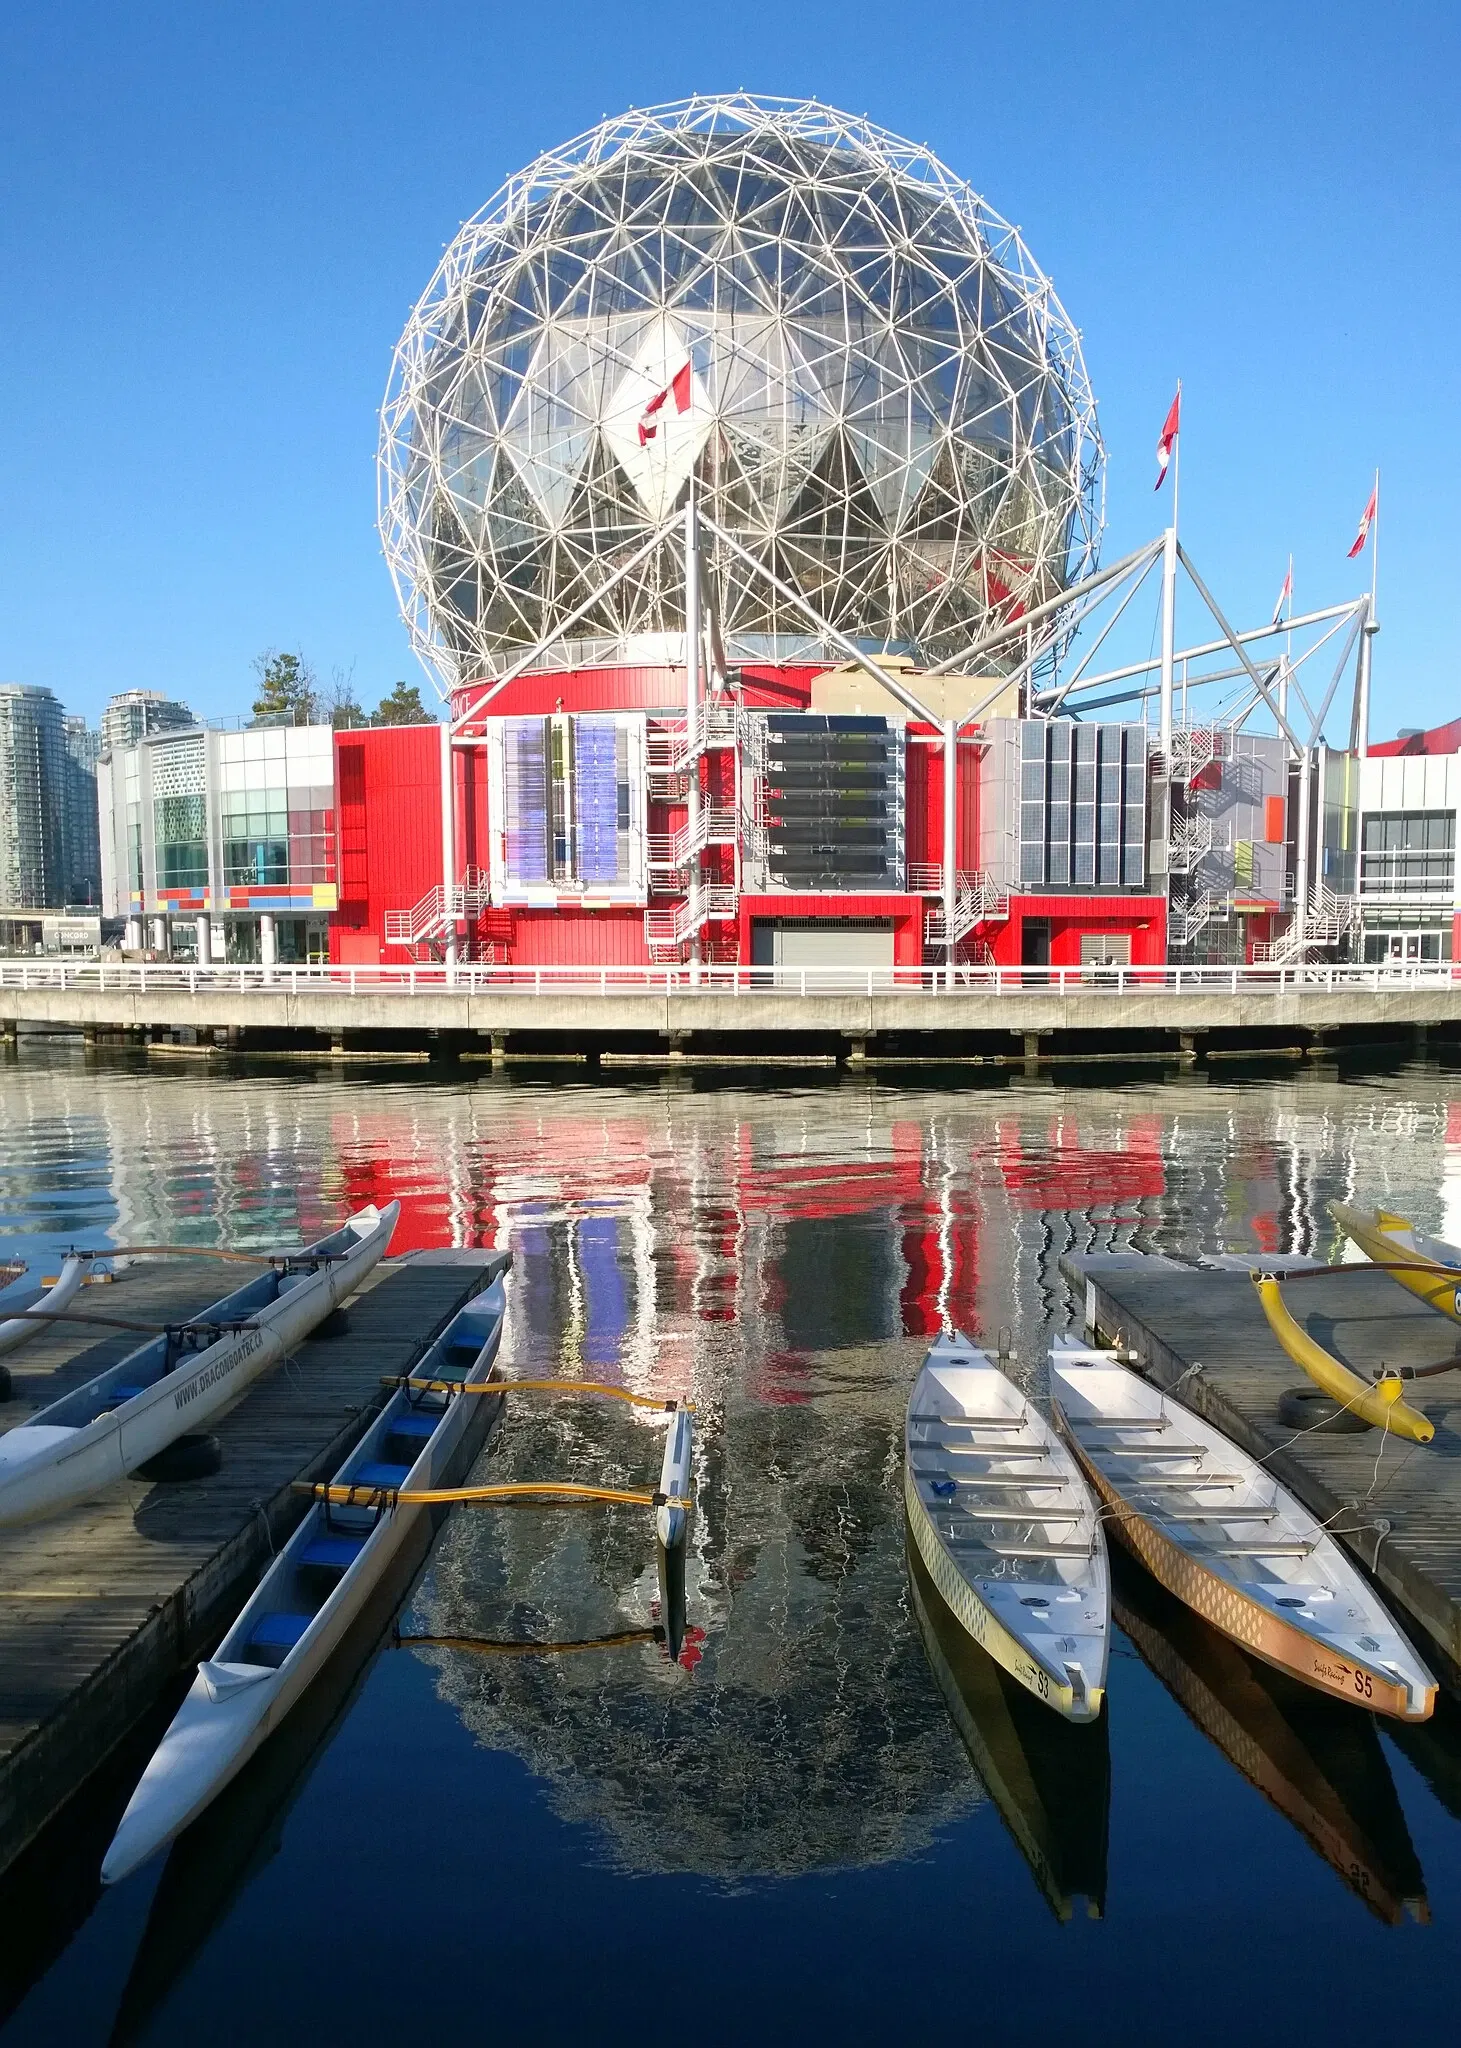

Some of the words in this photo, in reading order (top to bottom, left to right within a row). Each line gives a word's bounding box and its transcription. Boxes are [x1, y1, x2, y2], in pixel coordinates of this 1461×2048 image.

[173, 1332, 264, 1411] WWW.DRAGONBOATBC.CA
[1037, 1670, 1049, 1699] S3
[1354, 1669, 1373, 1699] S5
